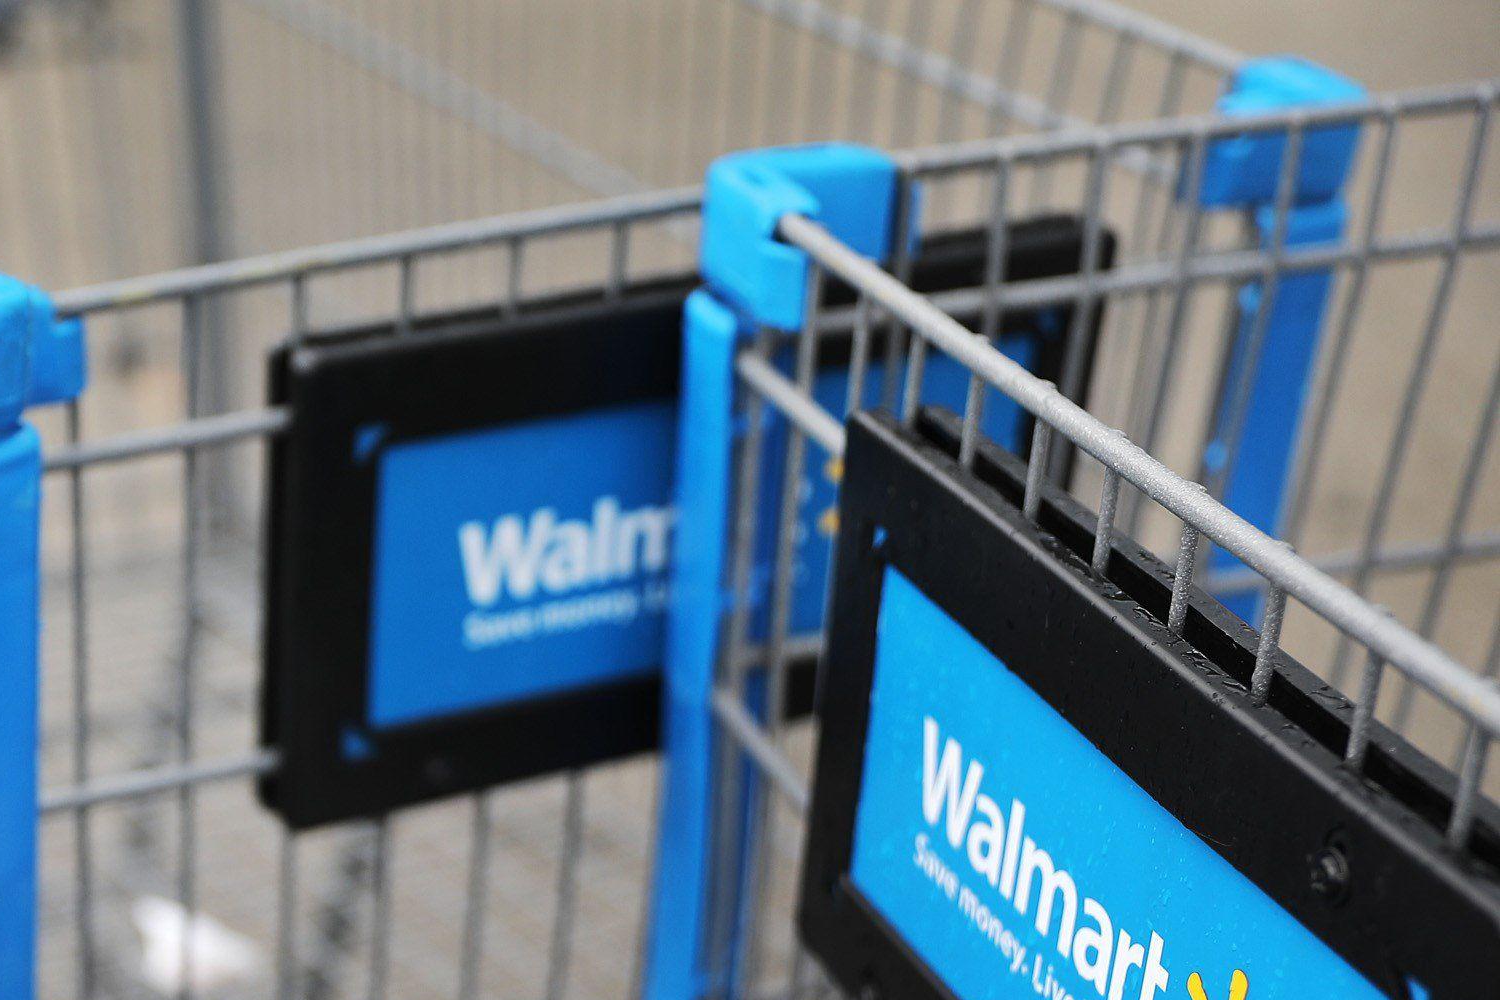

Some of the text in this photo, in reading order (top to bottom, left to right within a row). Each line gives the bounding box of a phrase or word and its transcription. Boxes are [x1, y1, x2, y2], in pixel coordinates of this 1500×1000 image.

[458, 496, 678, 606] Walm
[911, 832, 960, 901] Save
[958, 884, 1030, 975] money.
